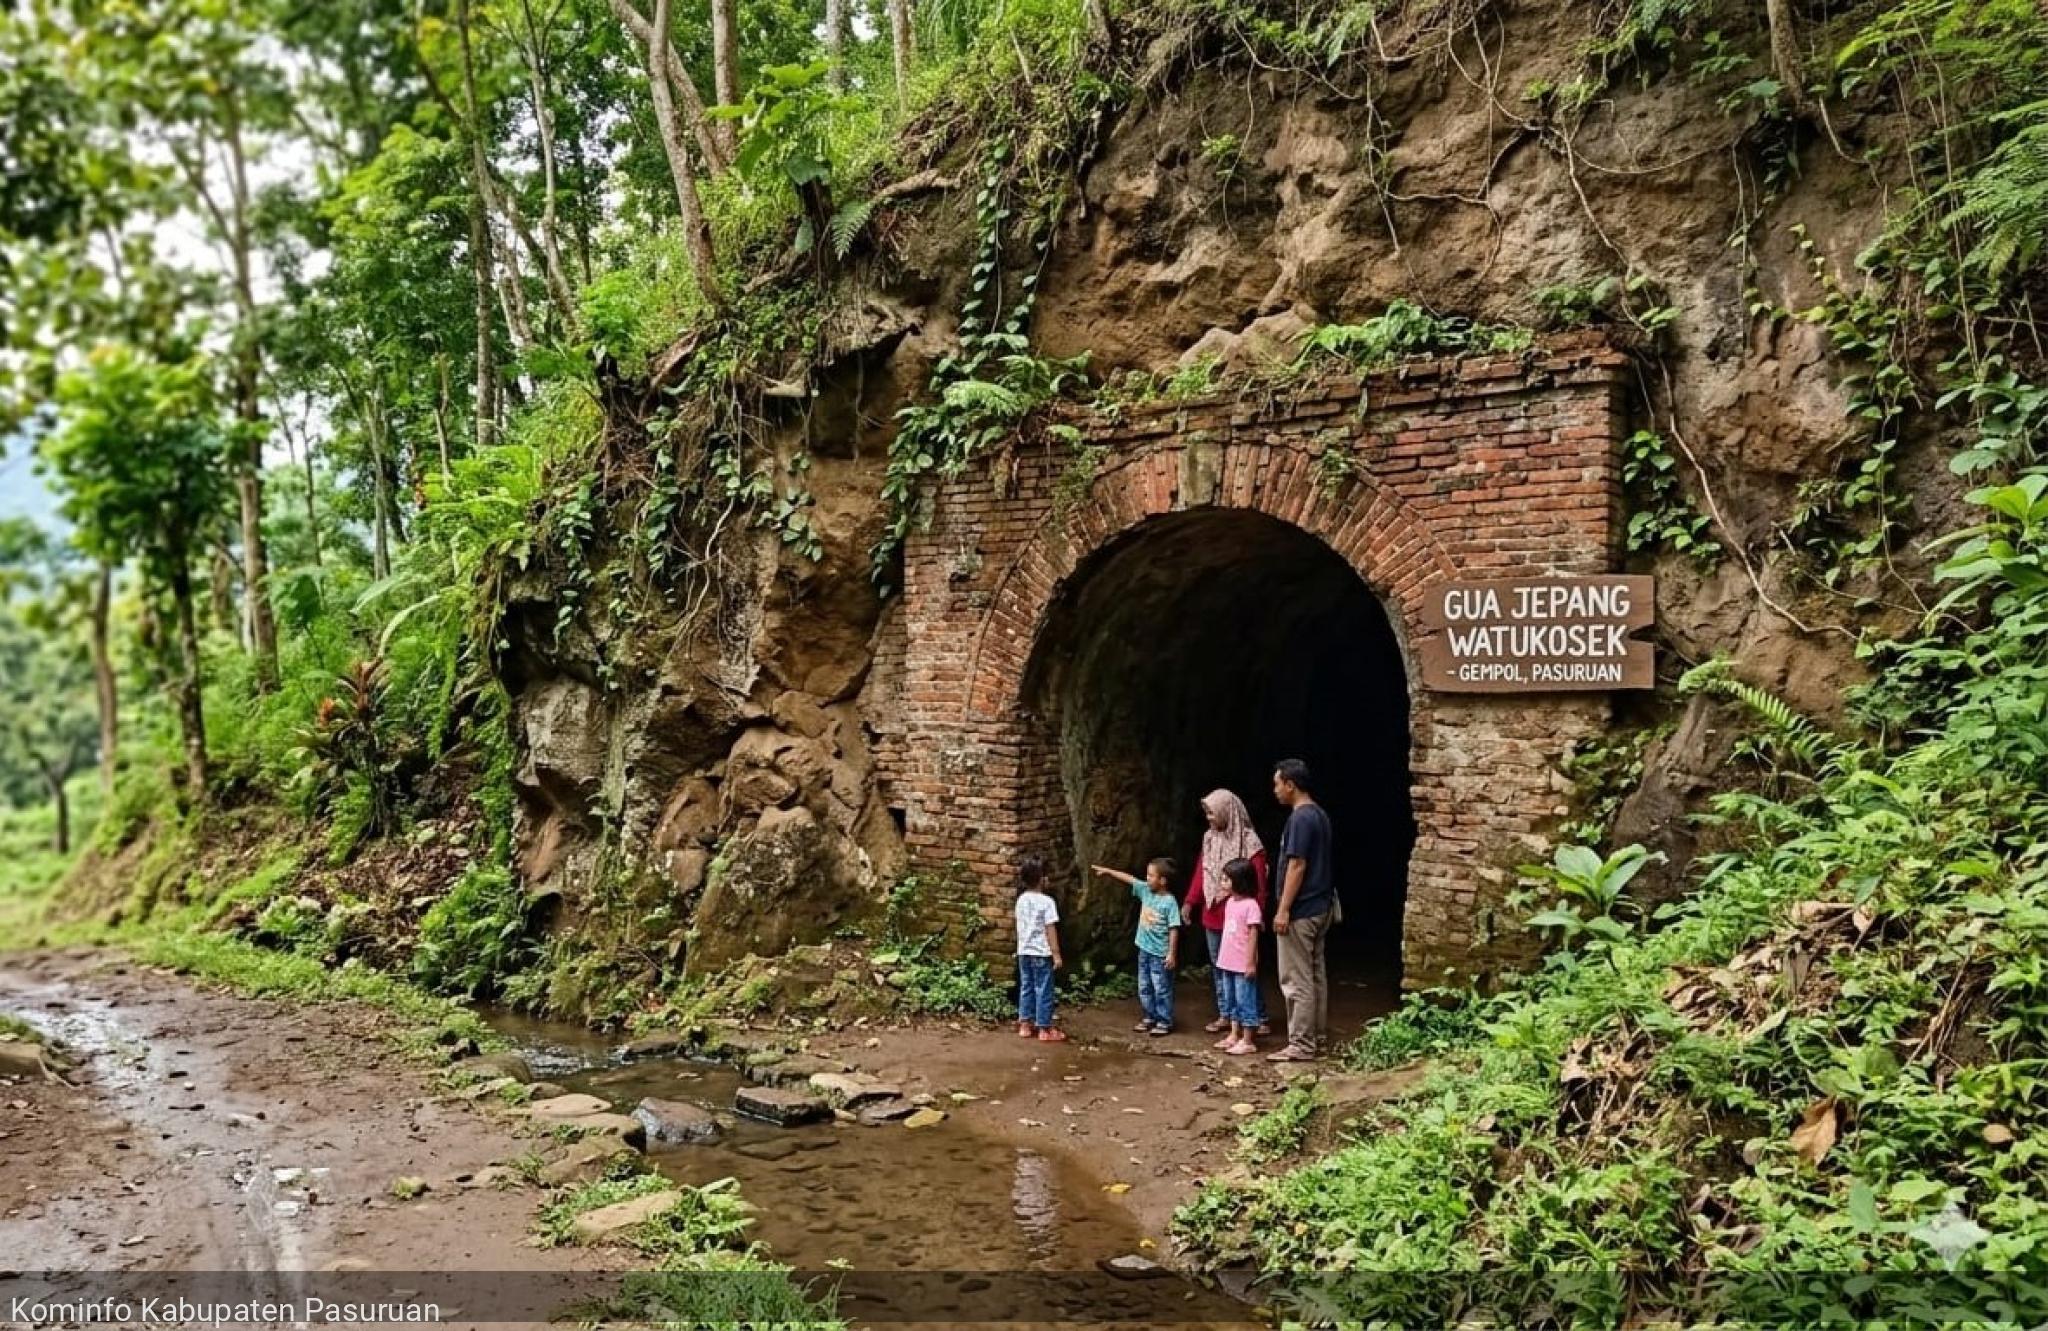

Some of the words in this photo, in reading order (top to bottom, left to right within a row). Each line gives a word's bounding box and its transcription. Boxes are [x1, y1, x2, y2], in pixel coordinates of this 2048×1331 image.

[1444, 589, 1501, 620] GUA
[1511, 585, 1631, 619] JEPANG
[1447, 624, 1628, 658] WATUKOSEK
[1459, 664, 1528, 684] GEMPOL,
[1532, 663, 1623, 682] PASURUAN
